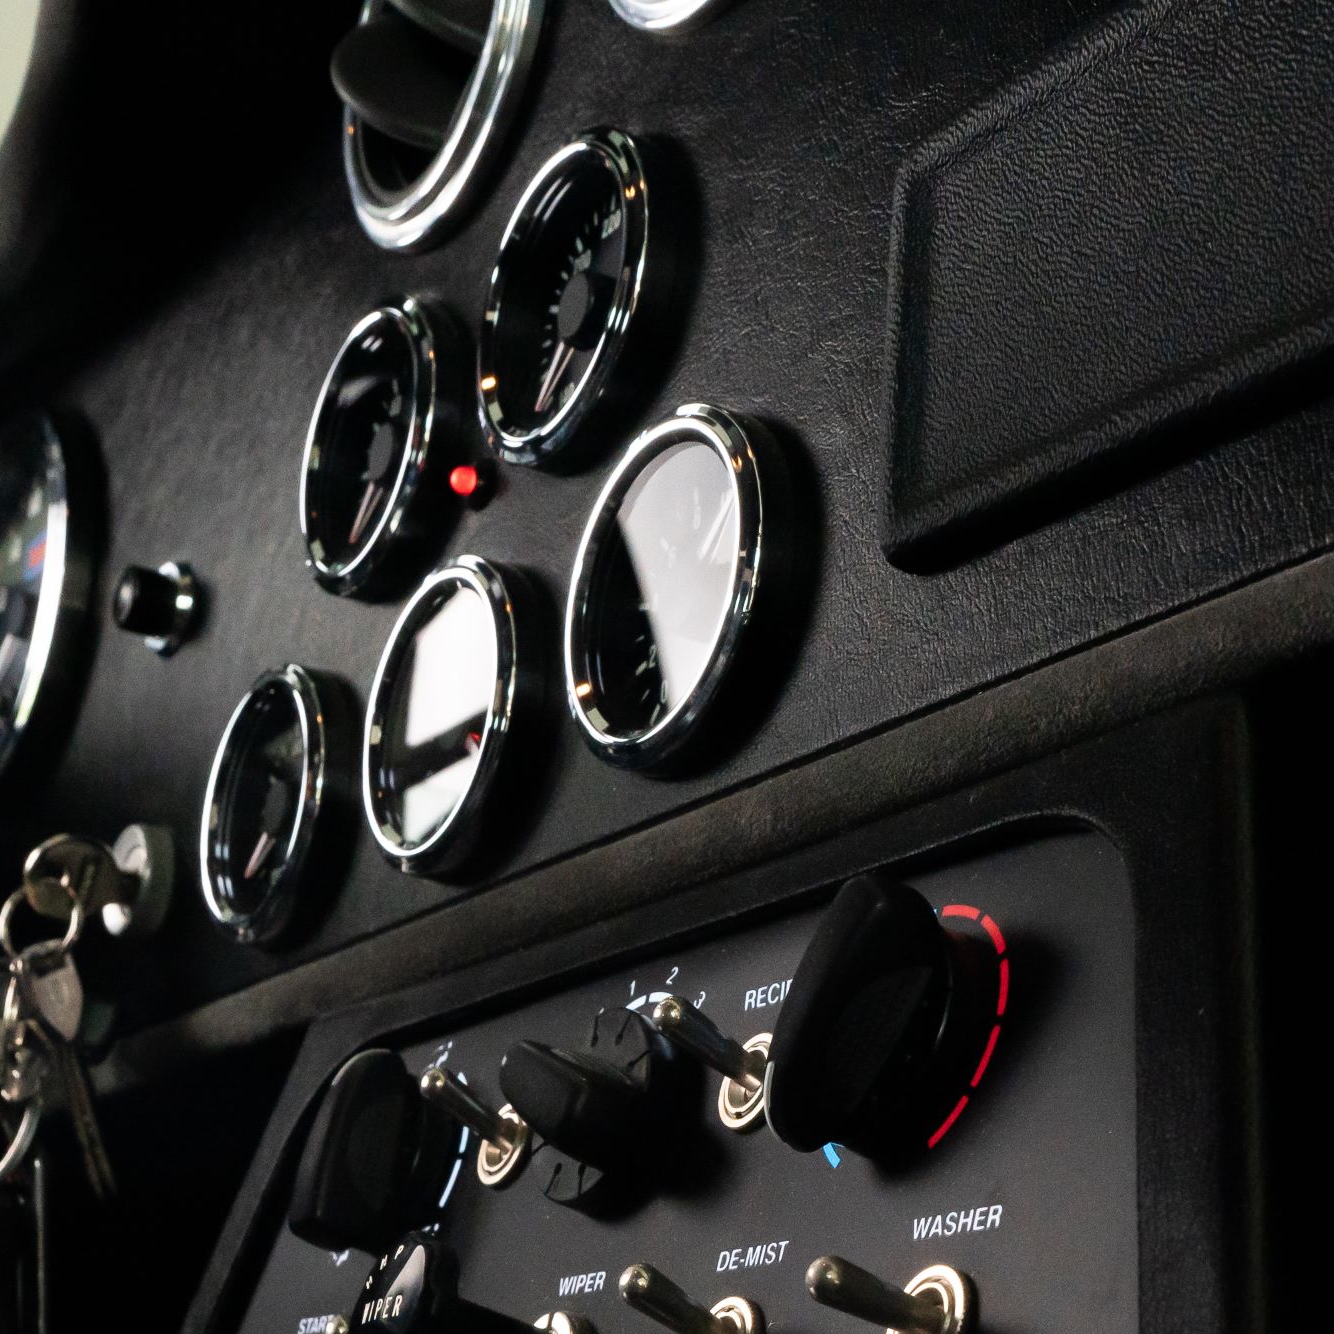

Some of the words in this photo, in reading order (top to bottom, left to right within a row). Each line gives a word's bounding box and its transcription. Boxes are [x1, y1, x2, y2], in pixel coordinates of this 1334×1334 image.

[630, 980, 636, 996] 1
[665, 966, 679, 985] 2
[913, 1204, 1003, 1240] WASHER
[716, 1240, 789, 1273] DE-MIST
[558, 1271, 607, 1297] WIPER
[361, 1294, 403, 1325] WIPER
